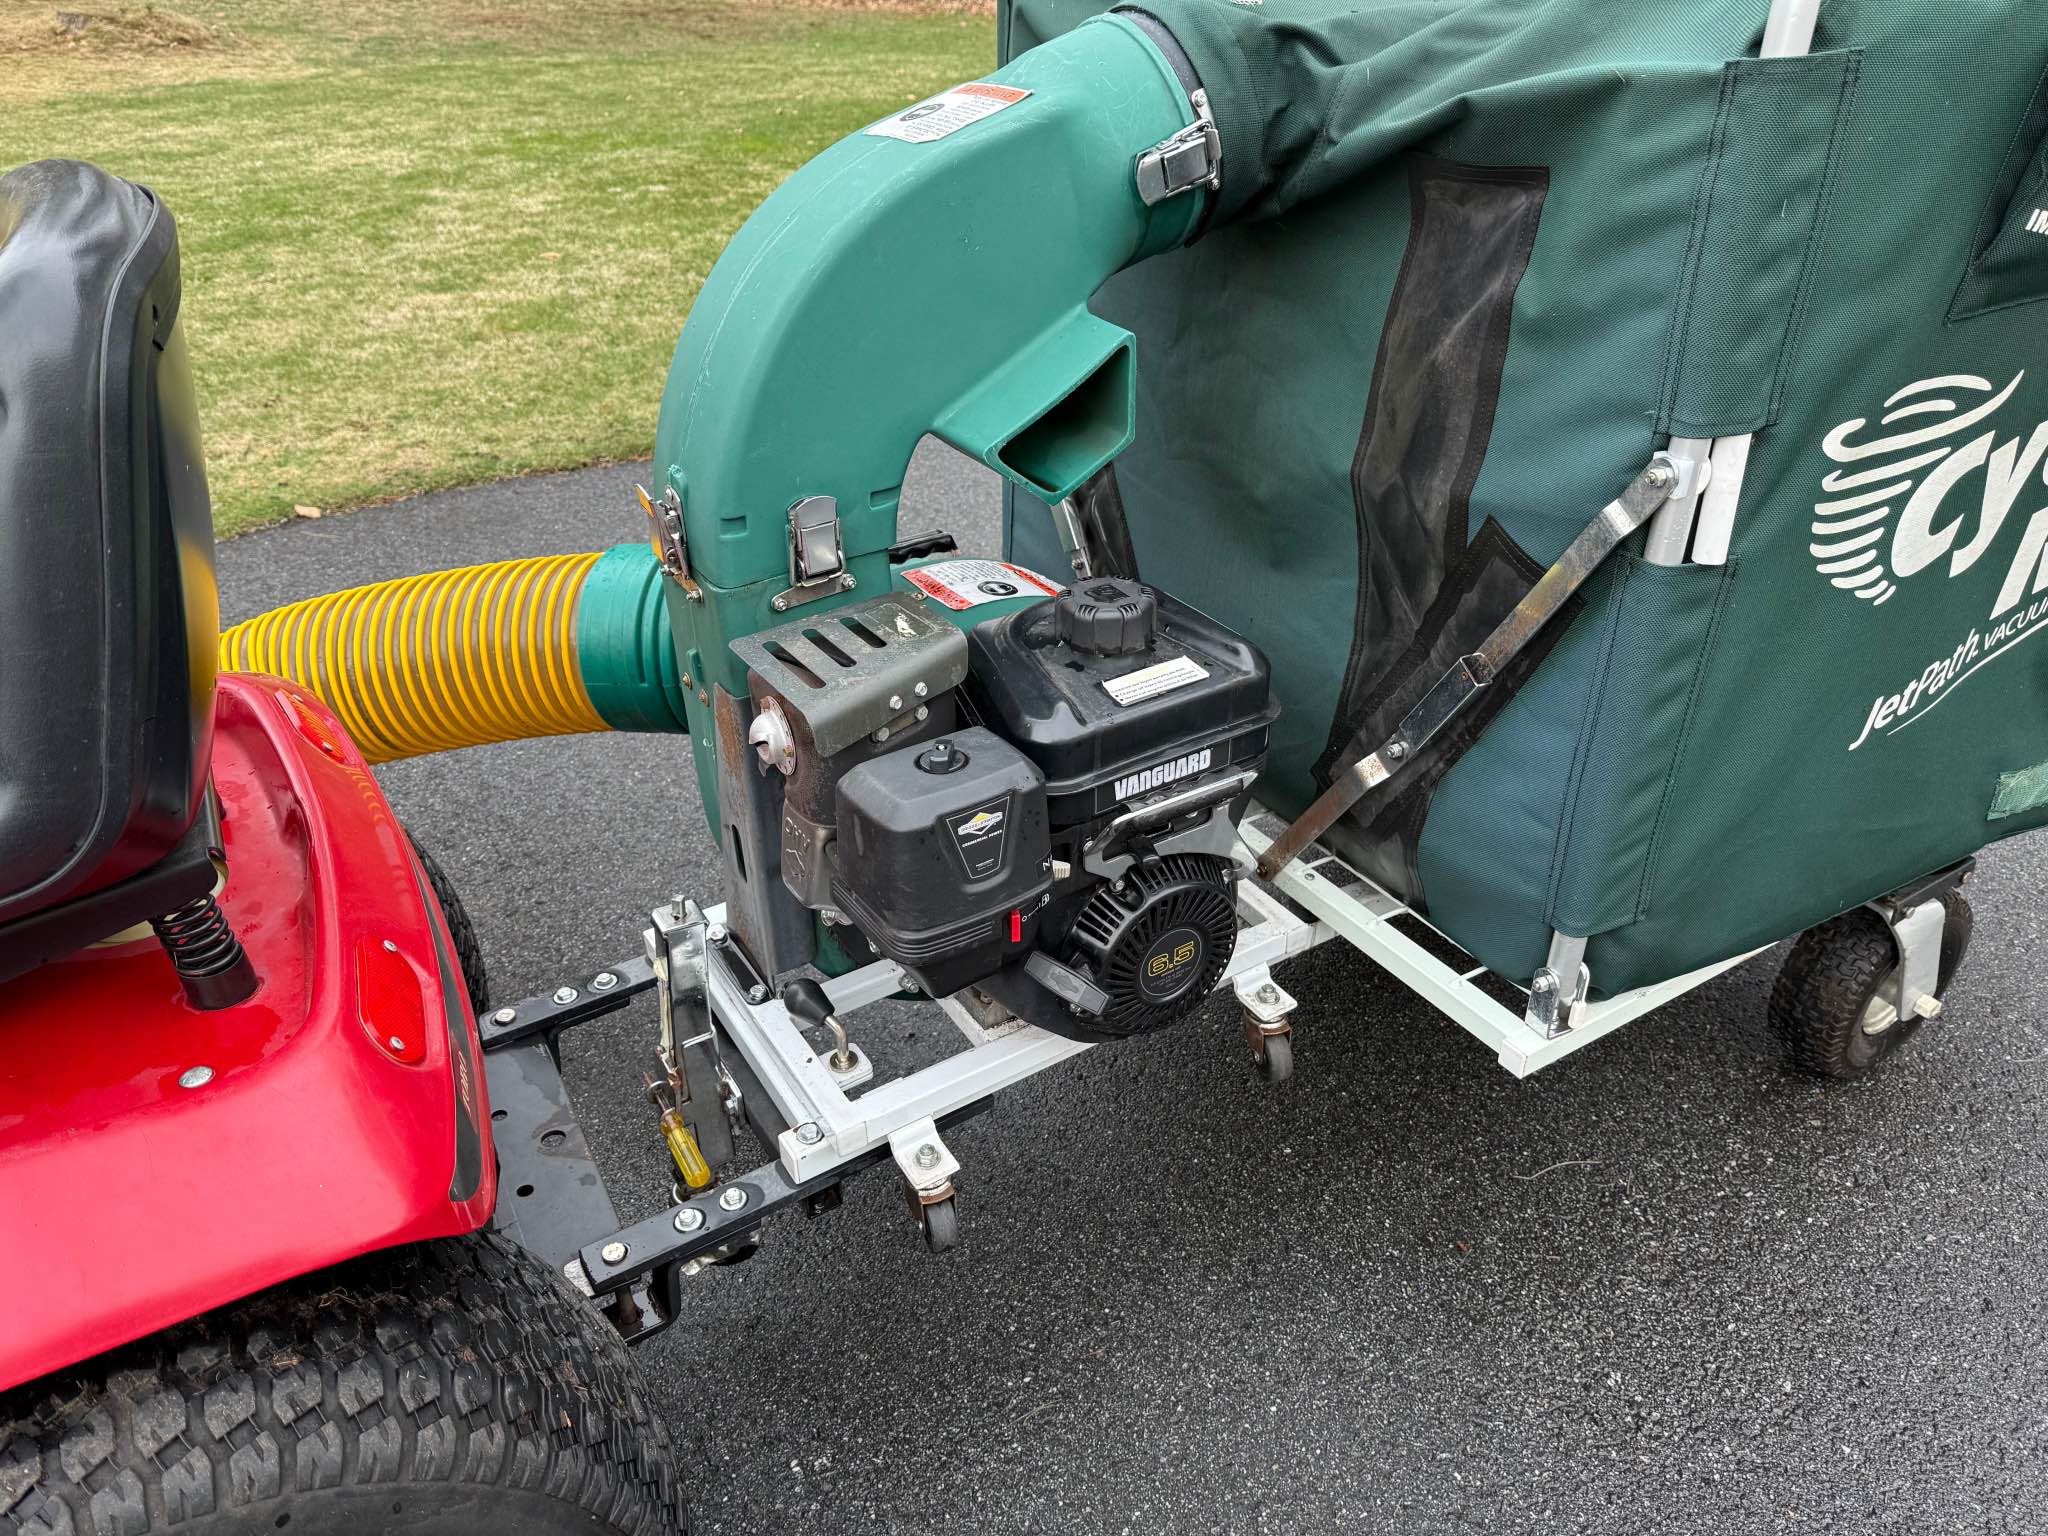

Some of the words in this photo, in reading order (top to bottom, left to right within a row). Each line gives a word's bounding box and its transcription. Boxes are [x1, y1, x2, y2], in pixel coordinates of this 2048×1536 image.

[1891, 420, 2048, 578] Cy
[1984, 597, 2048, 650] VACUU
[1114, 748, 1211, 801] VANGUARD
[1148, 941, 1195, 977] 6.5
